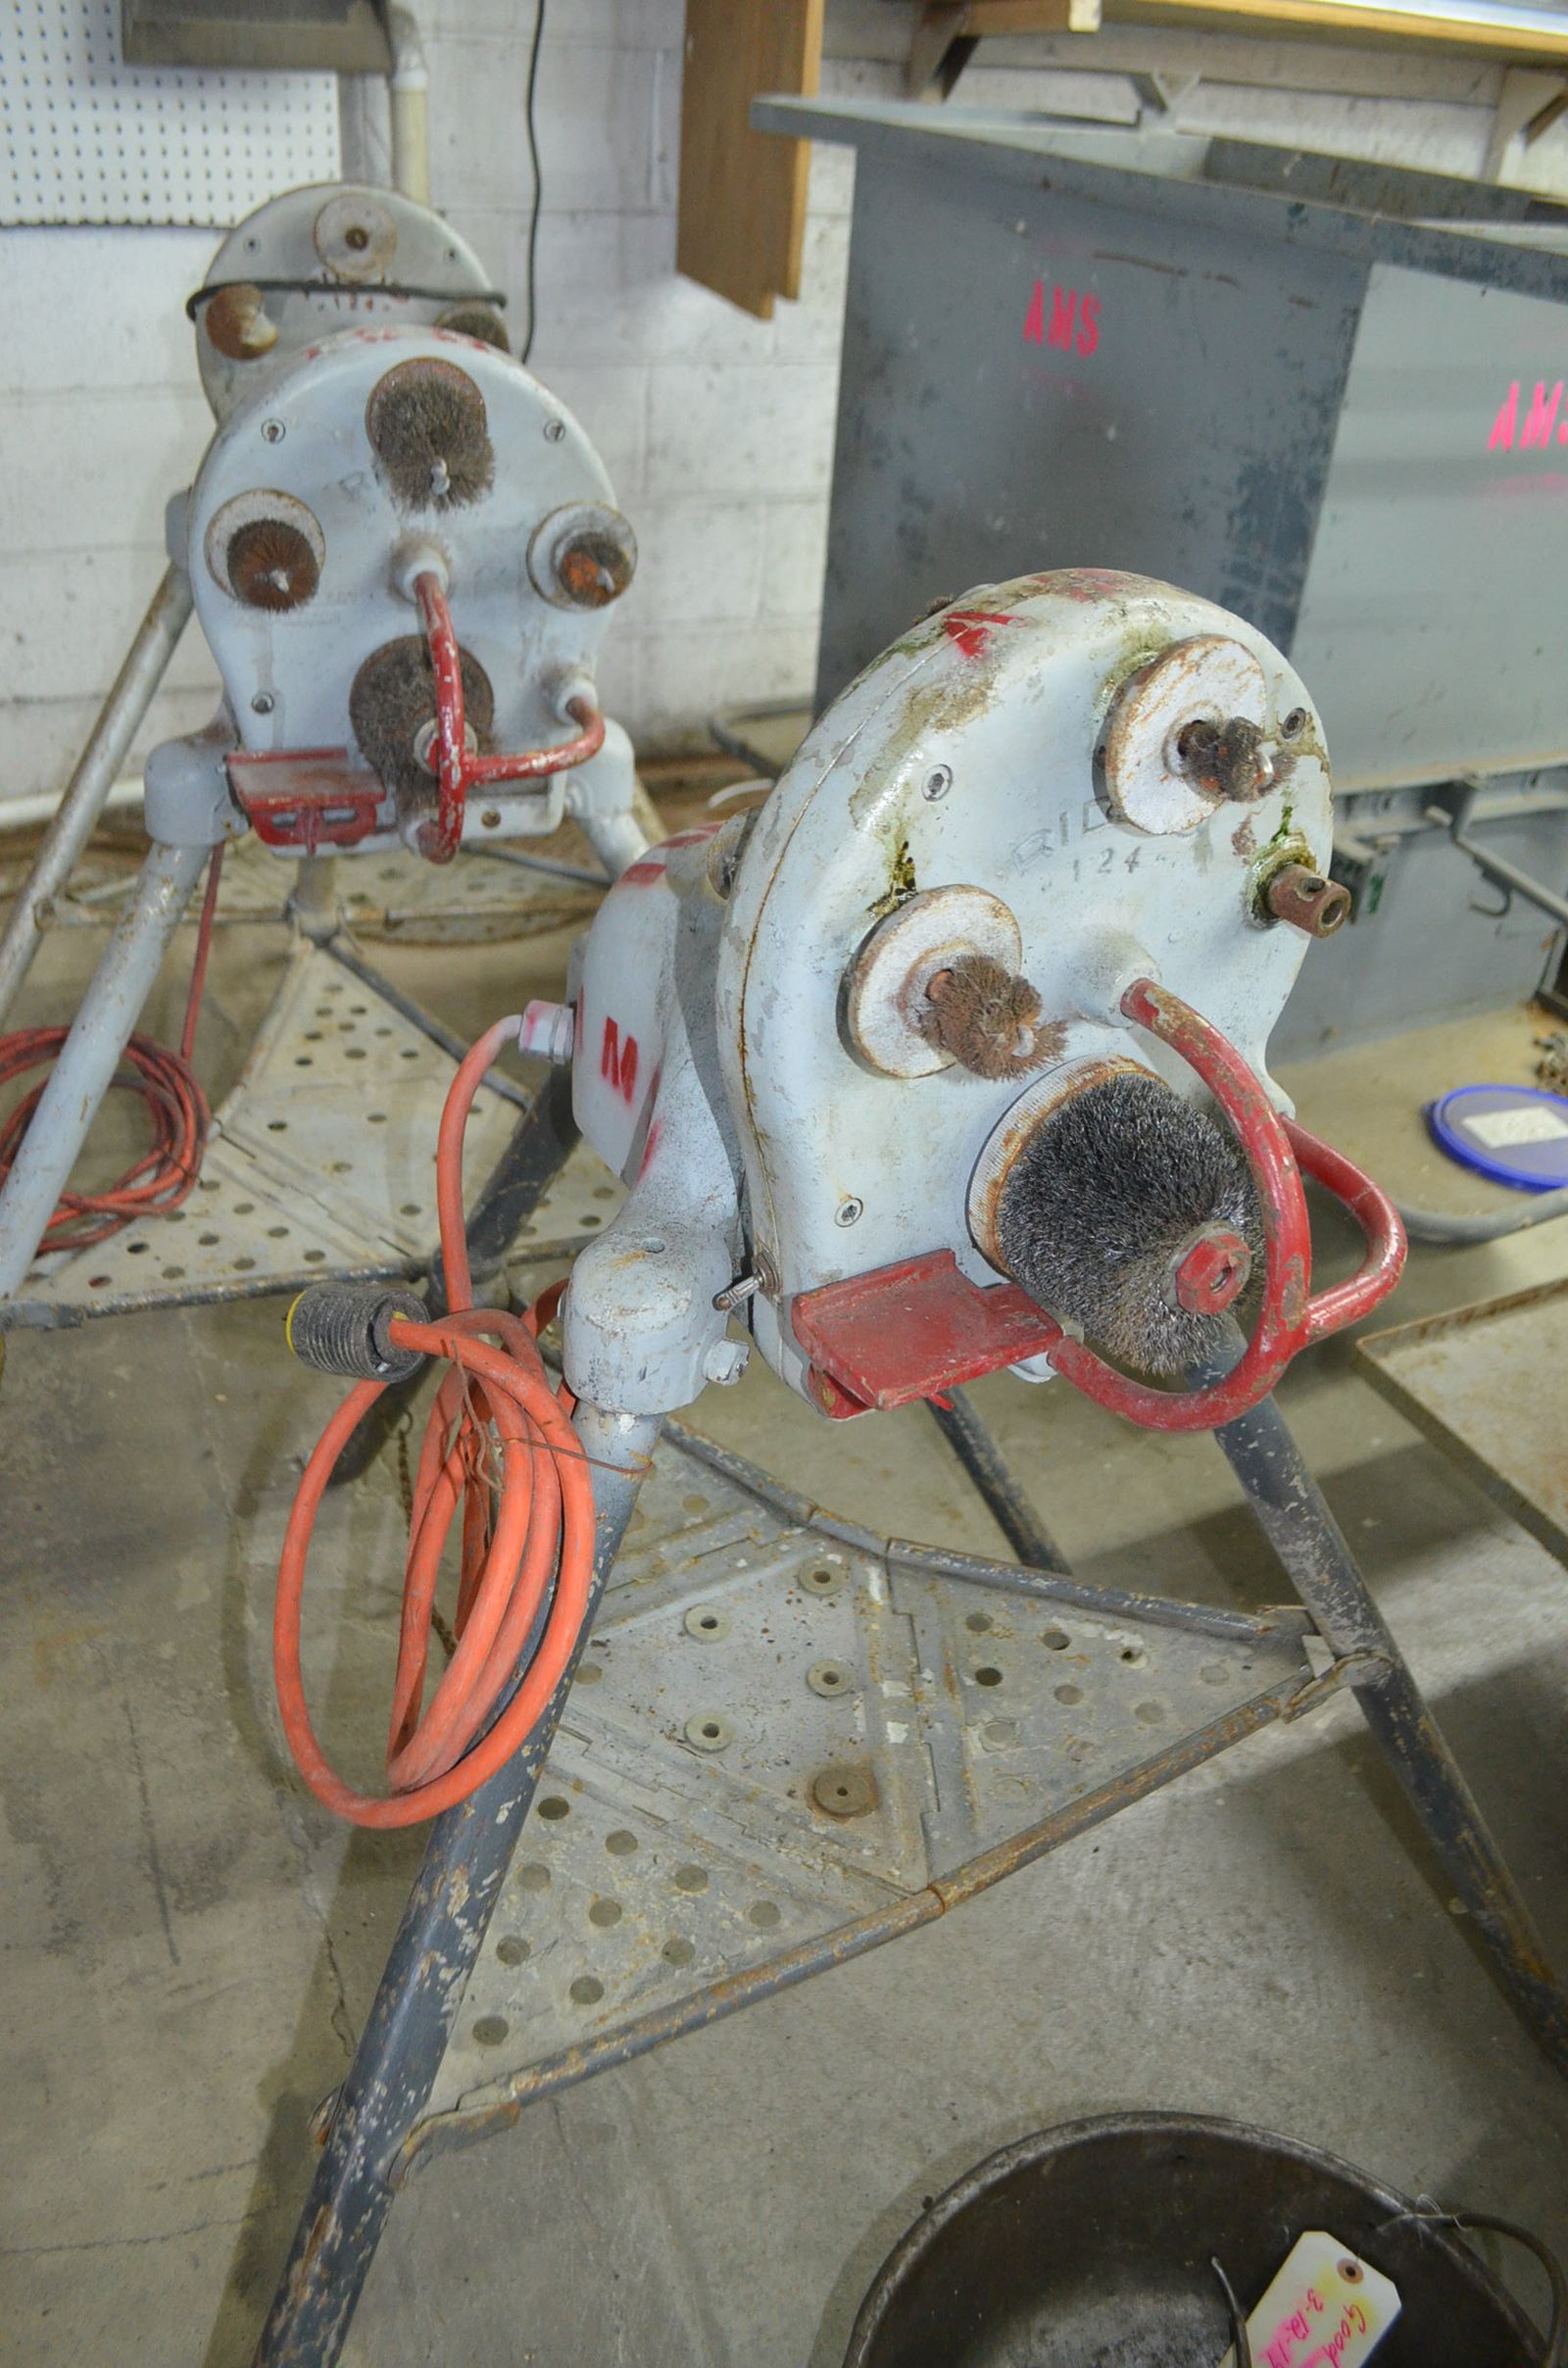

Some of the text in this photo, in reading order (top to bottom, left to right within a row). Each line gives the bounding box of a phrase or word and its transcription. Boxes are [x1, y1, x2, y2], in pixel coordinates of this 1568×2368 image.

[1023, 278, 1102, 359] AMS
[1488, 380, 1568, 452] AM
[1320, 2303, 1367, 2368] Good
